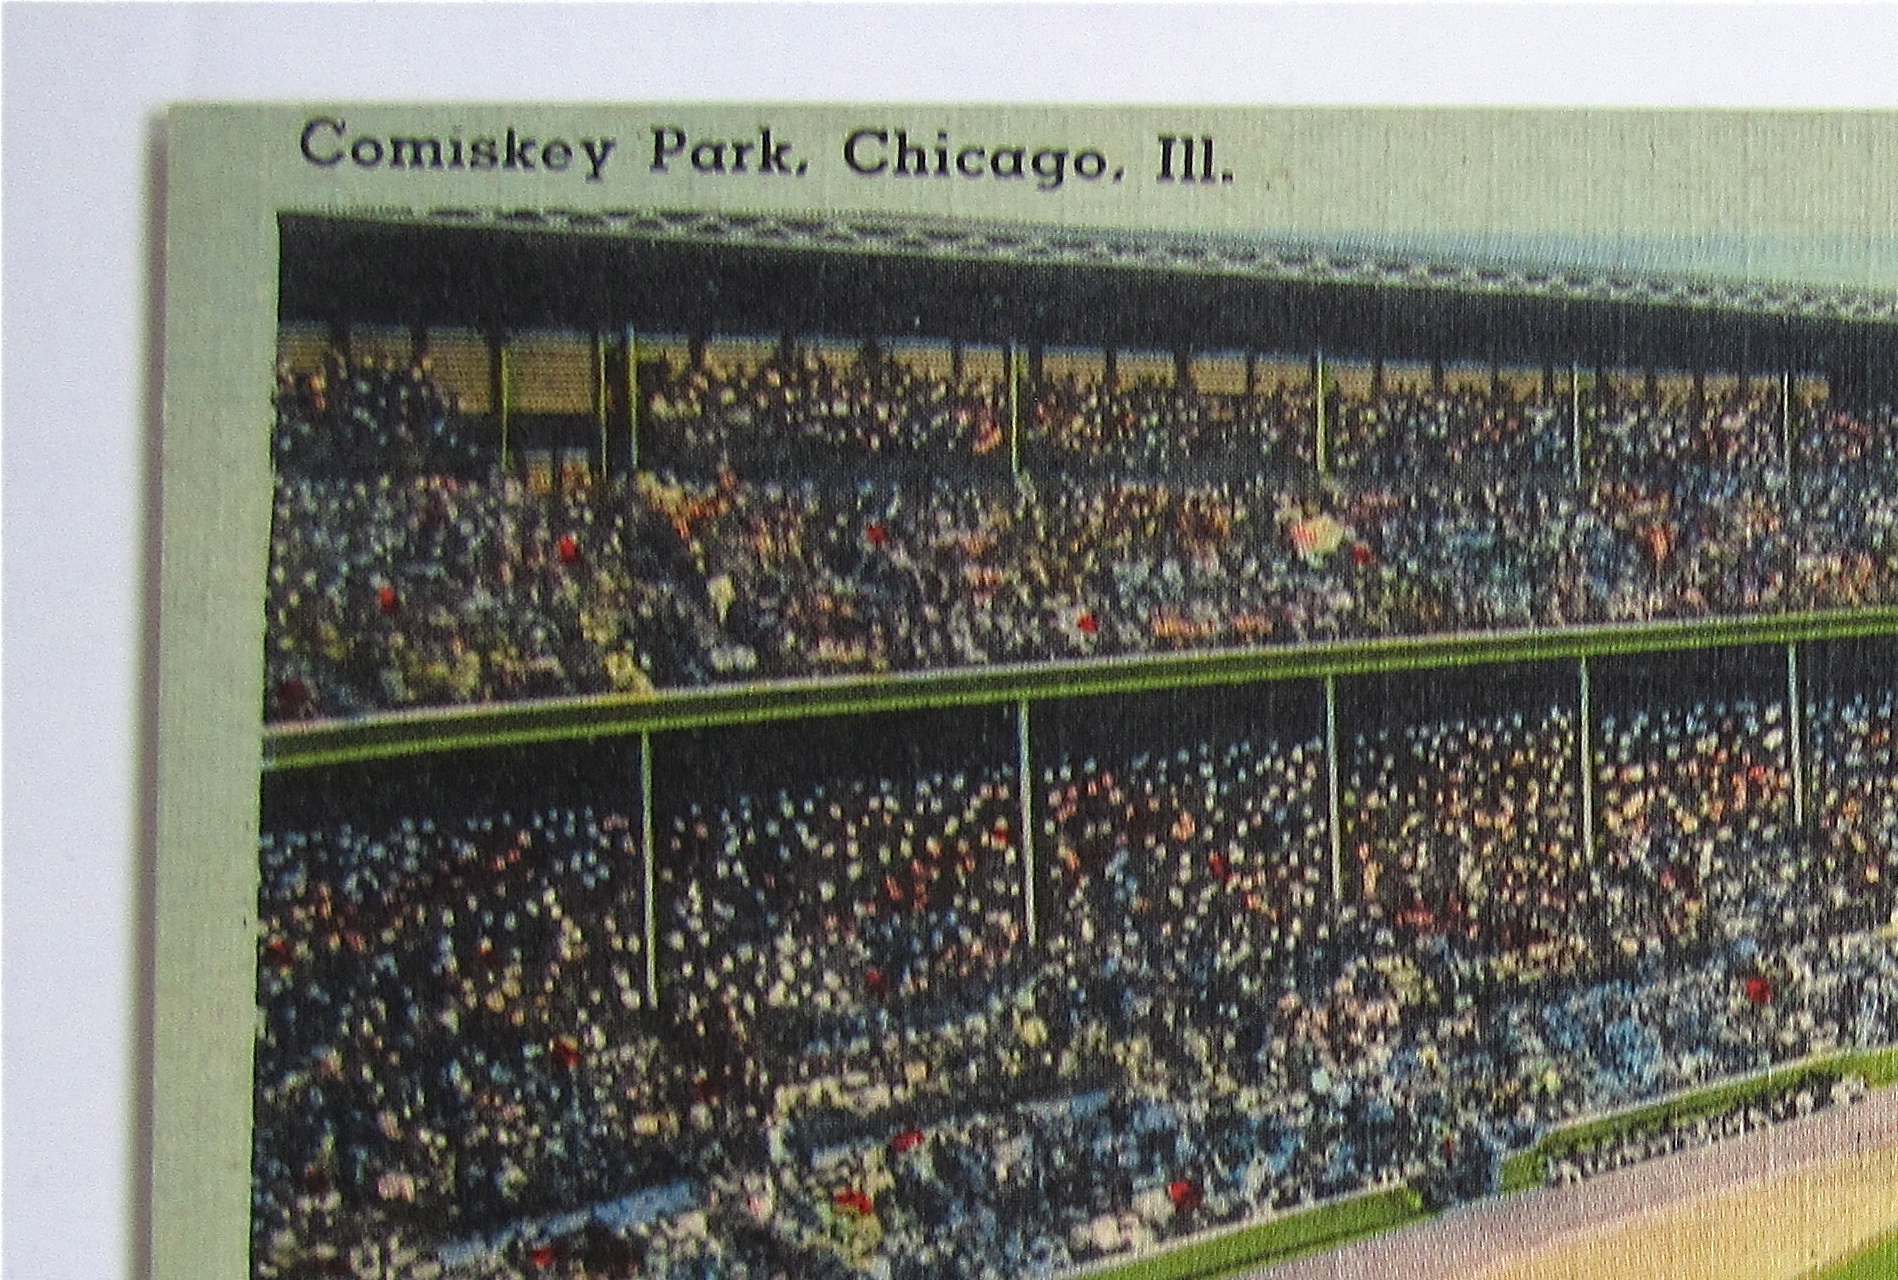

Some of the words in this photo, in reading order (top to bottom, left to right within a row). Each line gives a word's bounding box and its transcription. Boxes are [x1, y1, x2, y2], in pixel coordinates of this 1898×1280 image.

[299, 116, 617, 184] Comiskey
[650, 125, 809, 178] Park,
[842, 126, 1125, 192] Chicago,
[1156, 134, 1234, 184] Ill.
